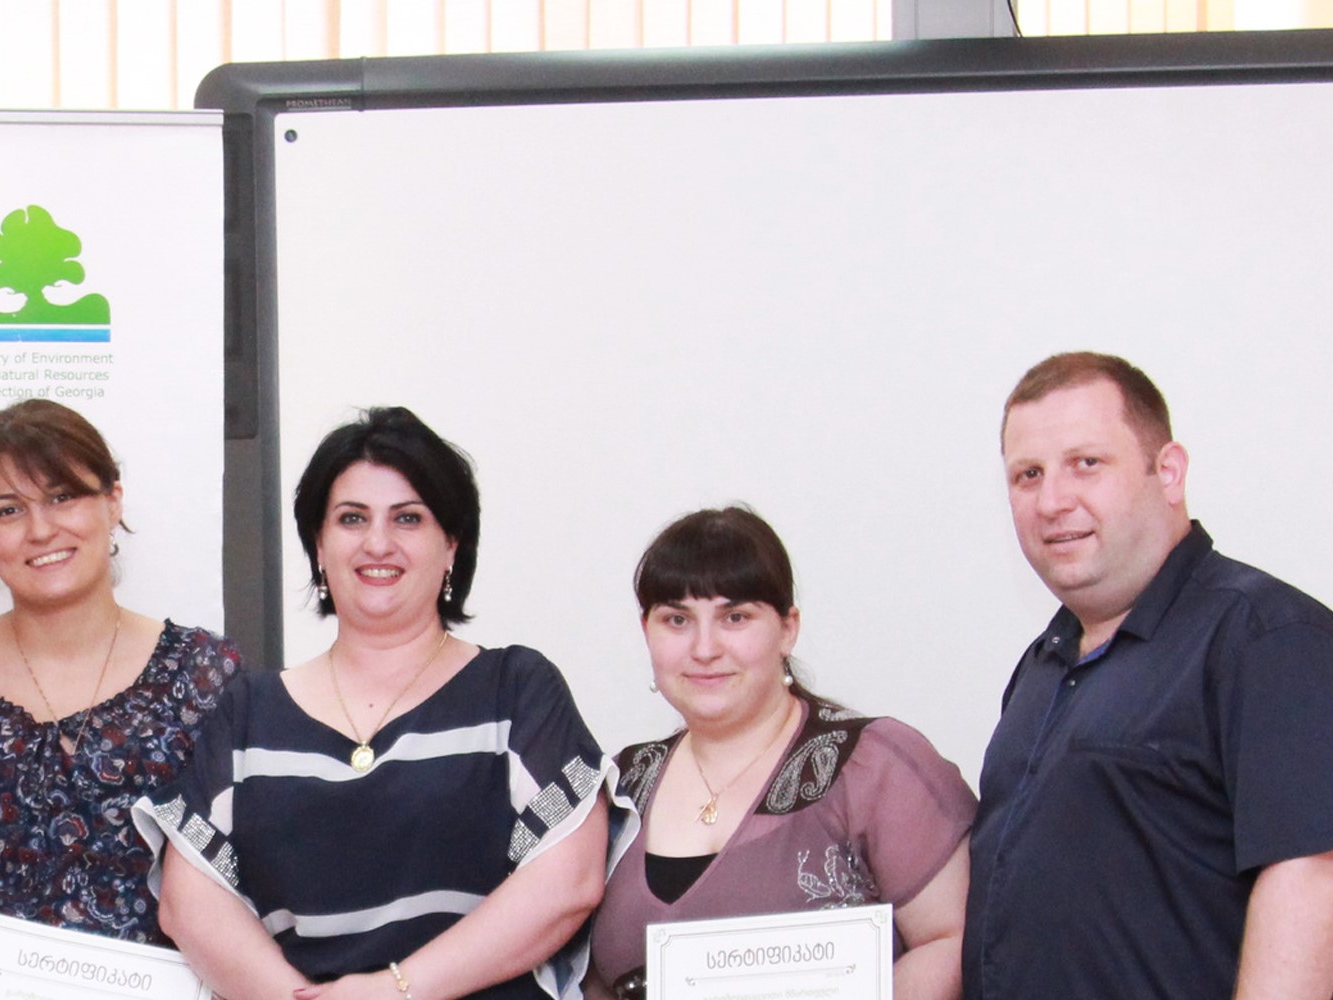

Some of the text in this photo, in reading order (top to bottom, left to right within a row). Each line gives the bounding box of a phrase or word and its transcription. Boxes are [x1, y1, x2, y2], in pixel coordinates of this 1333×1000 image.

[14, 352, 27, 364] of
[32, 352, 113, 364] Environment
[44, 369, 110, 381] Resources
[38, 386, 51, 398] of
[55, 386, 105, 400] Georgia
[706, 941, 835, 970] სერტიფიკატი
[17, 949, 153, 991] სერტიფიკატი
